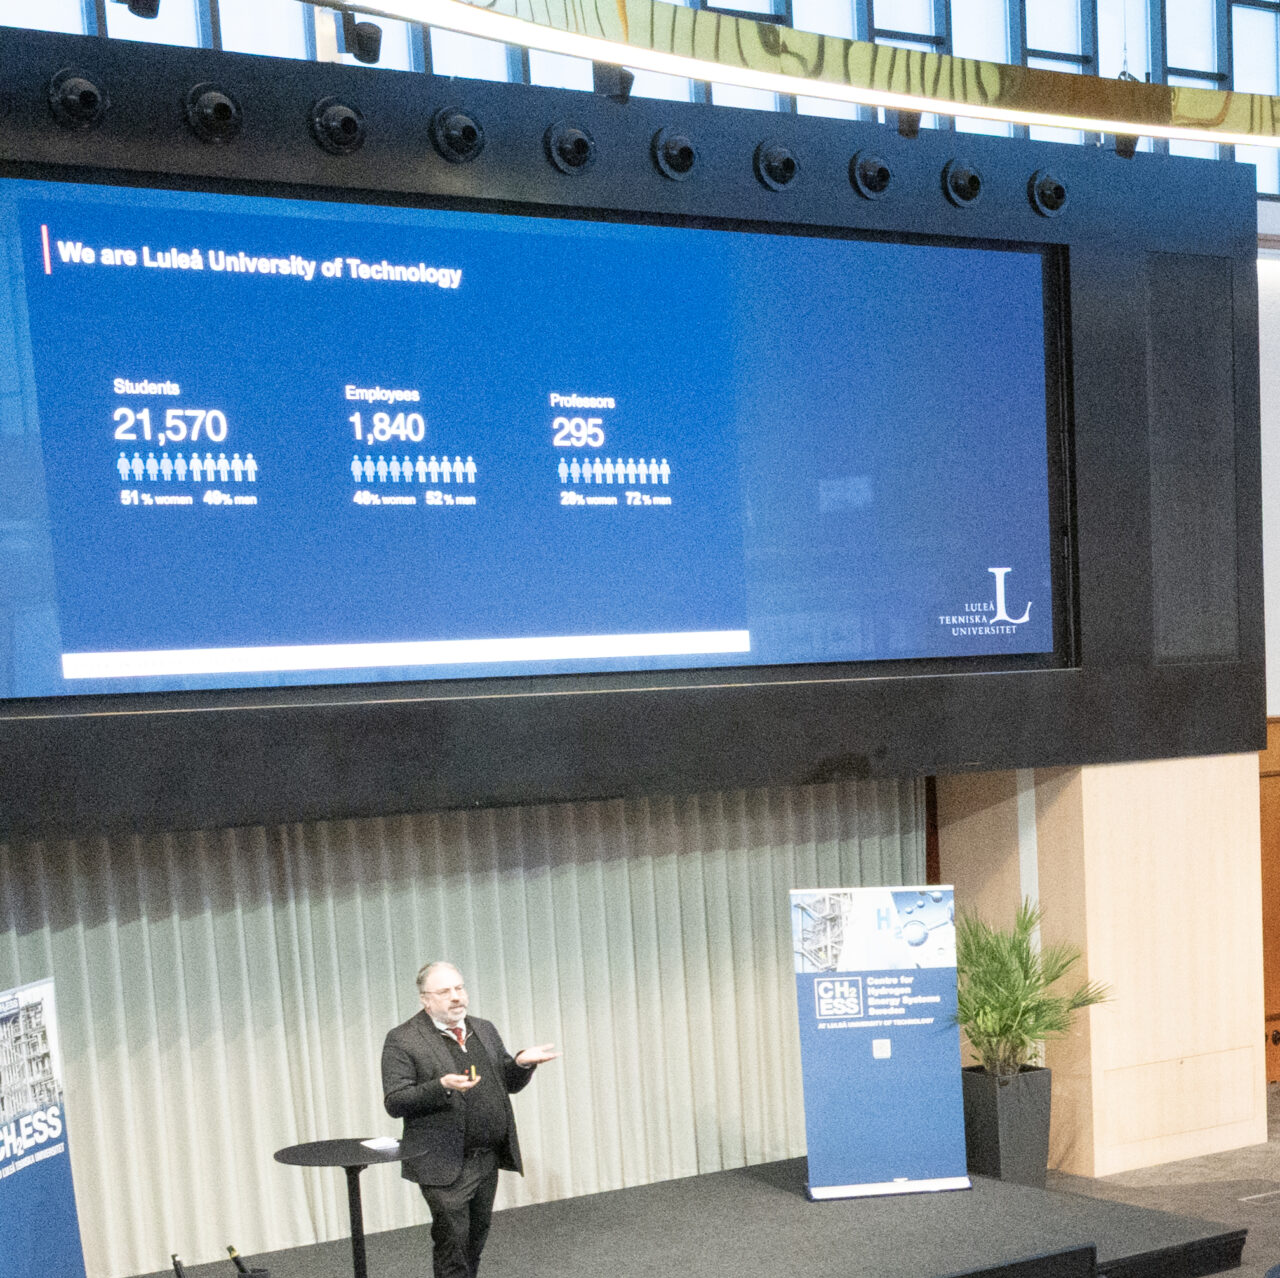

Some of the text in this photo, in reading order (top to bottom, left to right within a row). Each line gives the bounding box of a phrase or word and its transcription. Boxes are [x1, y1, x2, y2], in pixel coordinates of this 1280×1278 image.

[57, 240, 462, 289] We are Luleå University of Technology
[113, 377, 181, 396] Students
[344, 384, 421, 404] Employees
[550, 392, 616, 409] Professors
[113, 407, 228, 447] 21,570
[349, 411, 426, 446] 1,840
[552, 417, 605, 448] 295
[120, 489, 139, 506] 51
[154, 495, 193, 506] women
[234, 495, 258, 506] men
[381, 496, 416, 506] women
[455, 496, 477, 506] men
[586, 496, 618, 506] women
[653, 496, 672, 506] men
[964, 600, 995, 612] LULEÅ
[939, 615, 988, 625] TEKNISKA
[951, 625, 1017, 636] UNIVERSITET
[866, 976, 914, 985] Centre for
[866, 986, 911, 996] Hydrogen
[820, 997, 860, 1016] ESS
[867, 996, 940, 1006] Energy Systems
